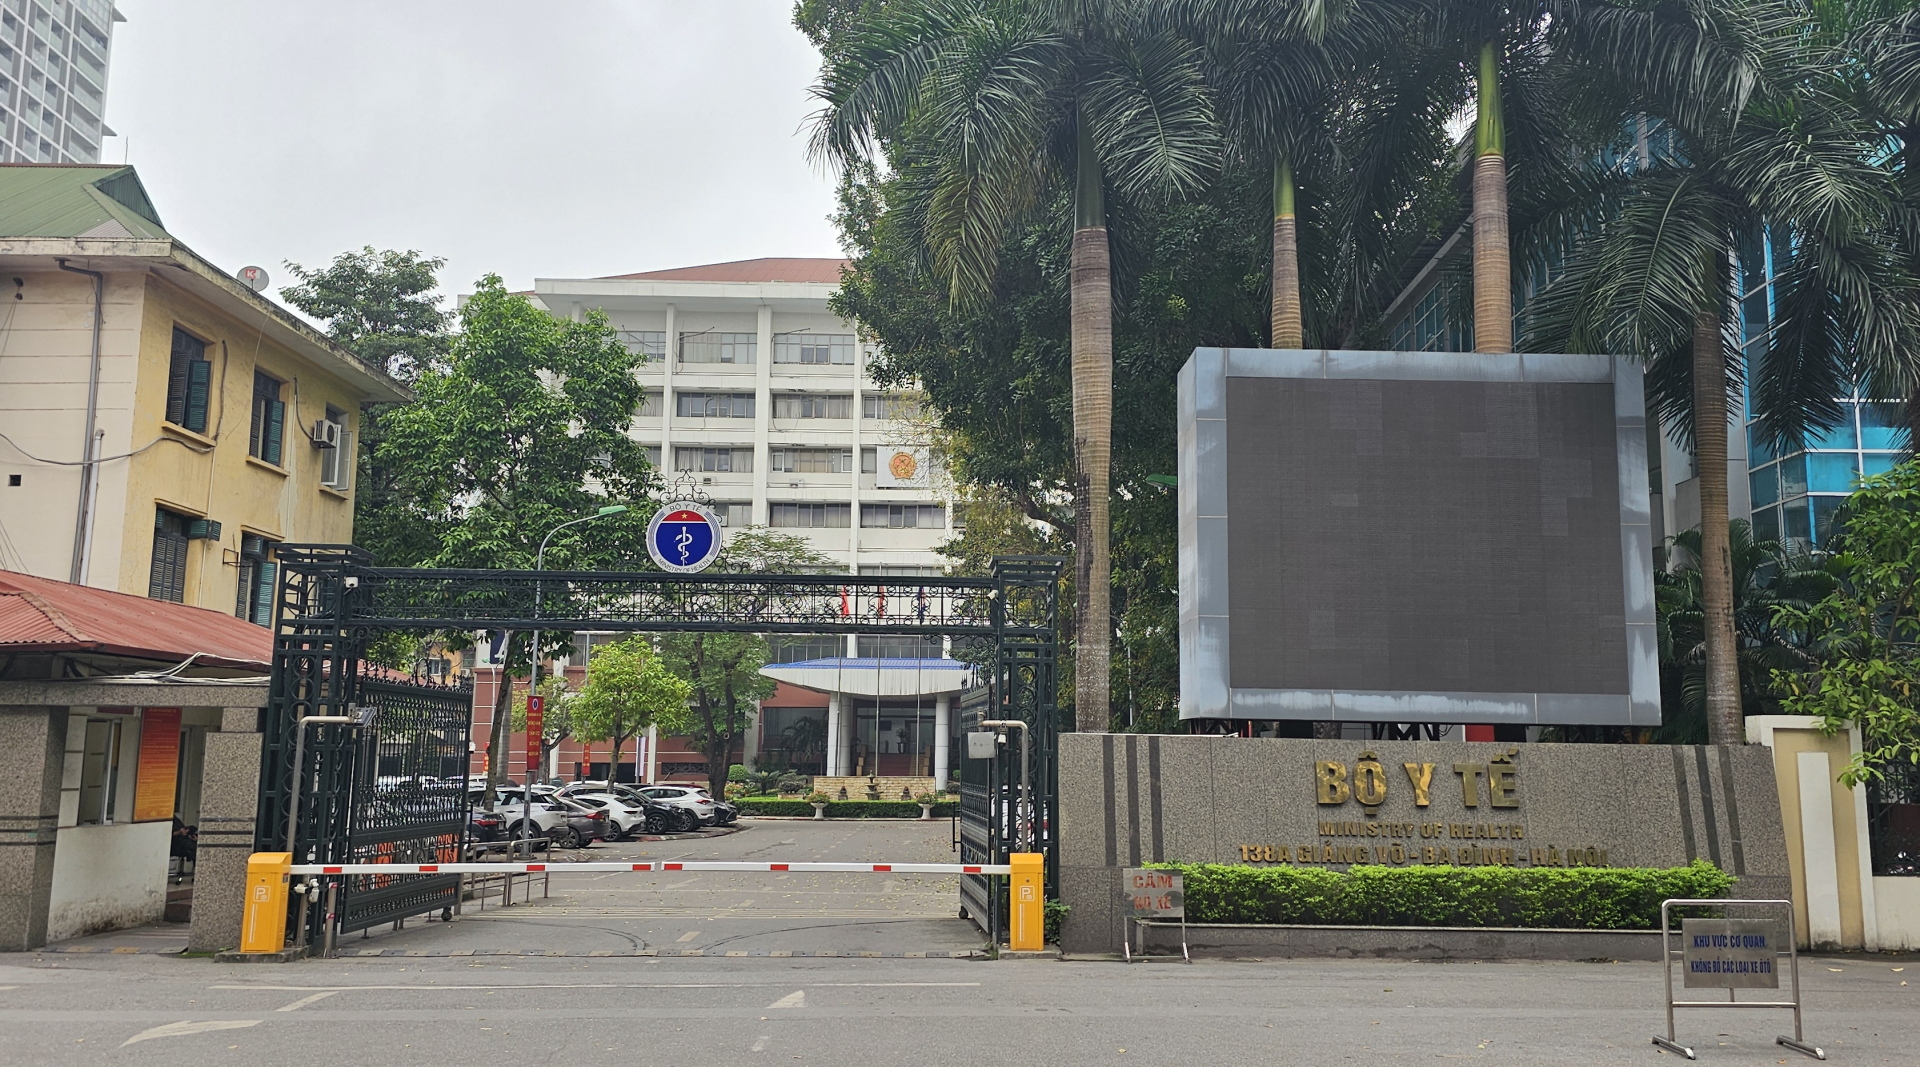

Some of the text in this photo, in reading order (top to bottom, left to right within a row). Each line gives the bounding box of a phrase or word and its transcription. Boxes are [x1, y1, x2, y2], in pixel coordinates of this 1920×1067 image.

[658, 559, 682, 572] MINISTRY
[691, 559, 711, 572] HEALTH
[1315, 747, 1520, 815] BỘ Y TẾ
[1319, 821, 1523, 839] MINISTRY OF HEALTH
[1240, 844, 1292, 863] 138A
[1297, 840, 1370, 864] GIẢNG
[1375, 843, 1405, 864] VÕ
[1422, 846, 1453, 864] BA
[1458, 843, 1515, 865] ĐÌNH
[1531, 844, 1563, 866] HÀ
[1156, 896, 1171, 910] XE
[1693, 934, 1766, 951] KHU VỰC CƠ QUAN
[1691, 958, 1712, 973] KHÔNG
[1722, 958, 1734, 973] CÁC
[1735, 961, 1749, 976] LOẠI
[1751, 961, 1758, 973] XE
